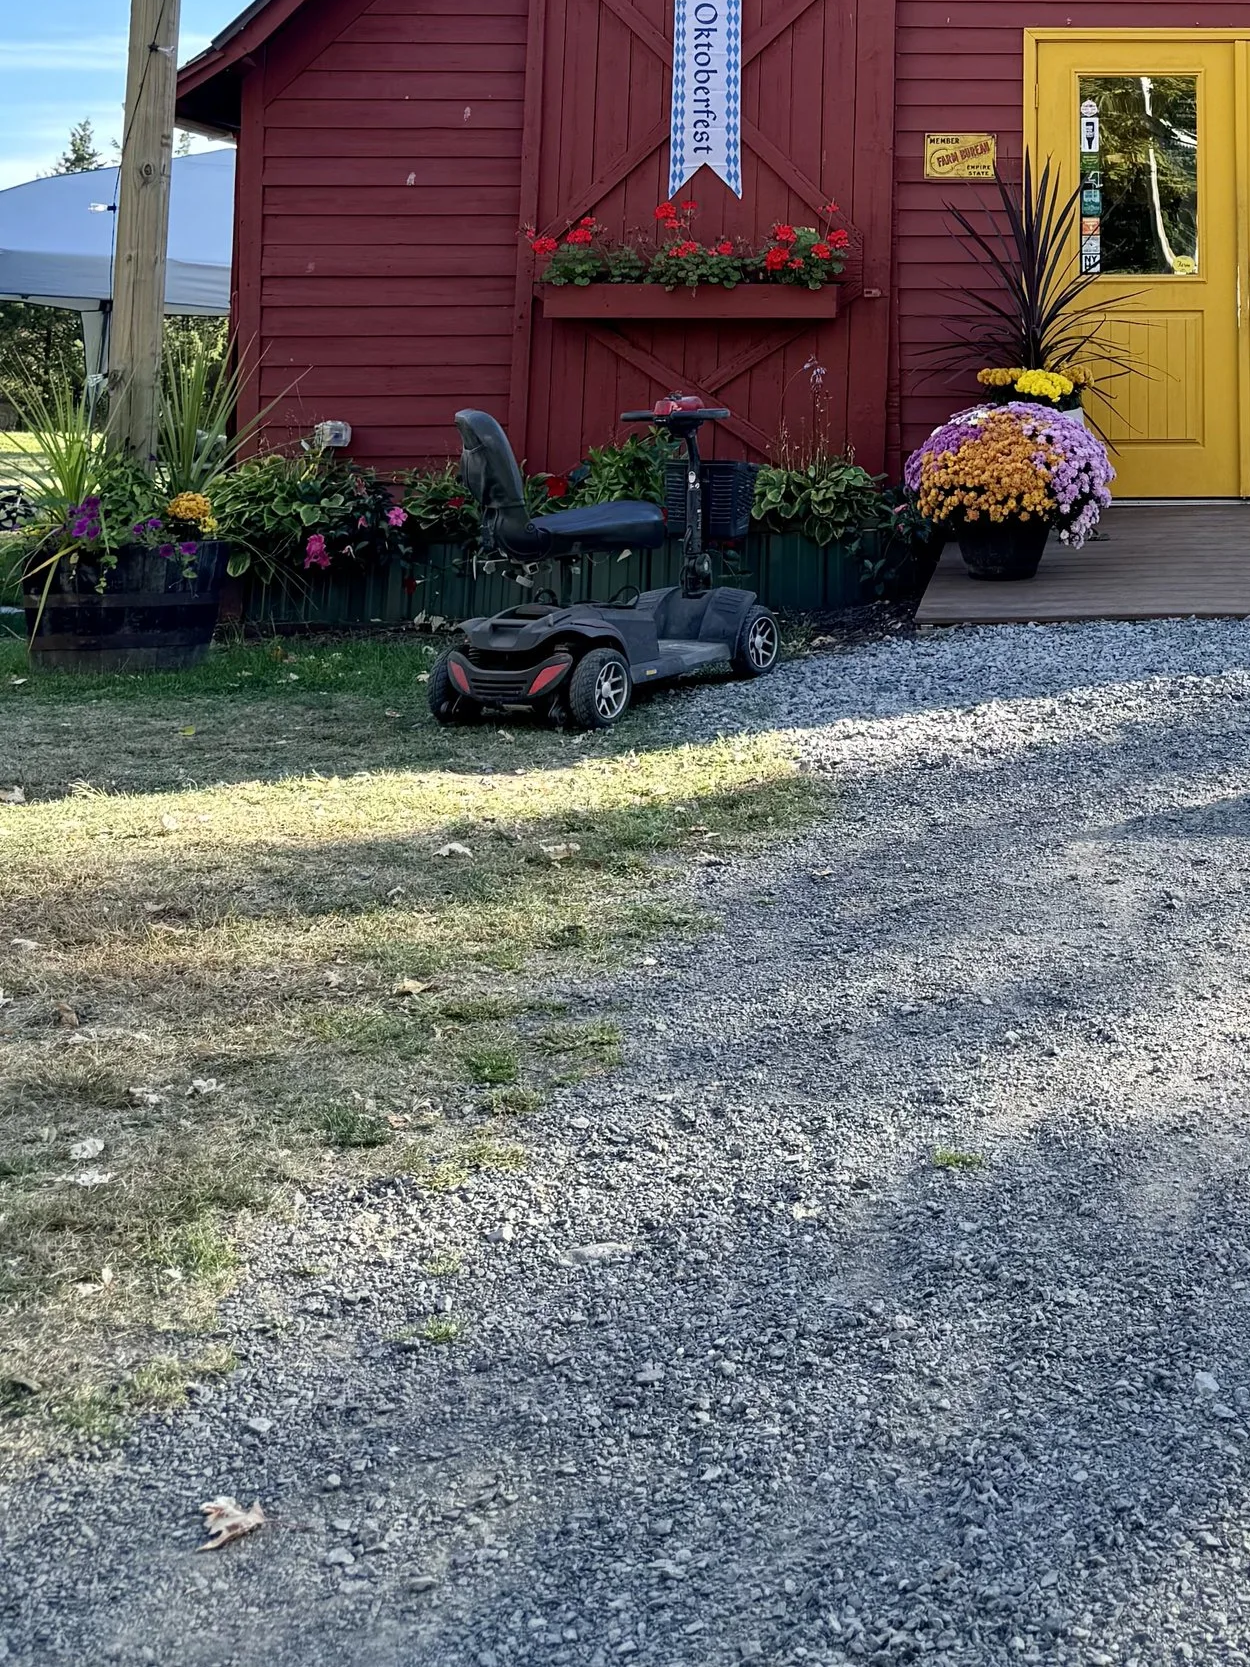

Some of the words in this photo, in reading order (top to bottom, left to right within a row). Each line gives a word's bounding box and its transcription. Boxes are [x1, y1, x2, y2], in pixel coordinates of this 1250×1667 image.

[693, 2, 718, 155] Oktoberfest
[937, 151, 960, 167] FARM
[960, 141, 990, 160] BUREAU
